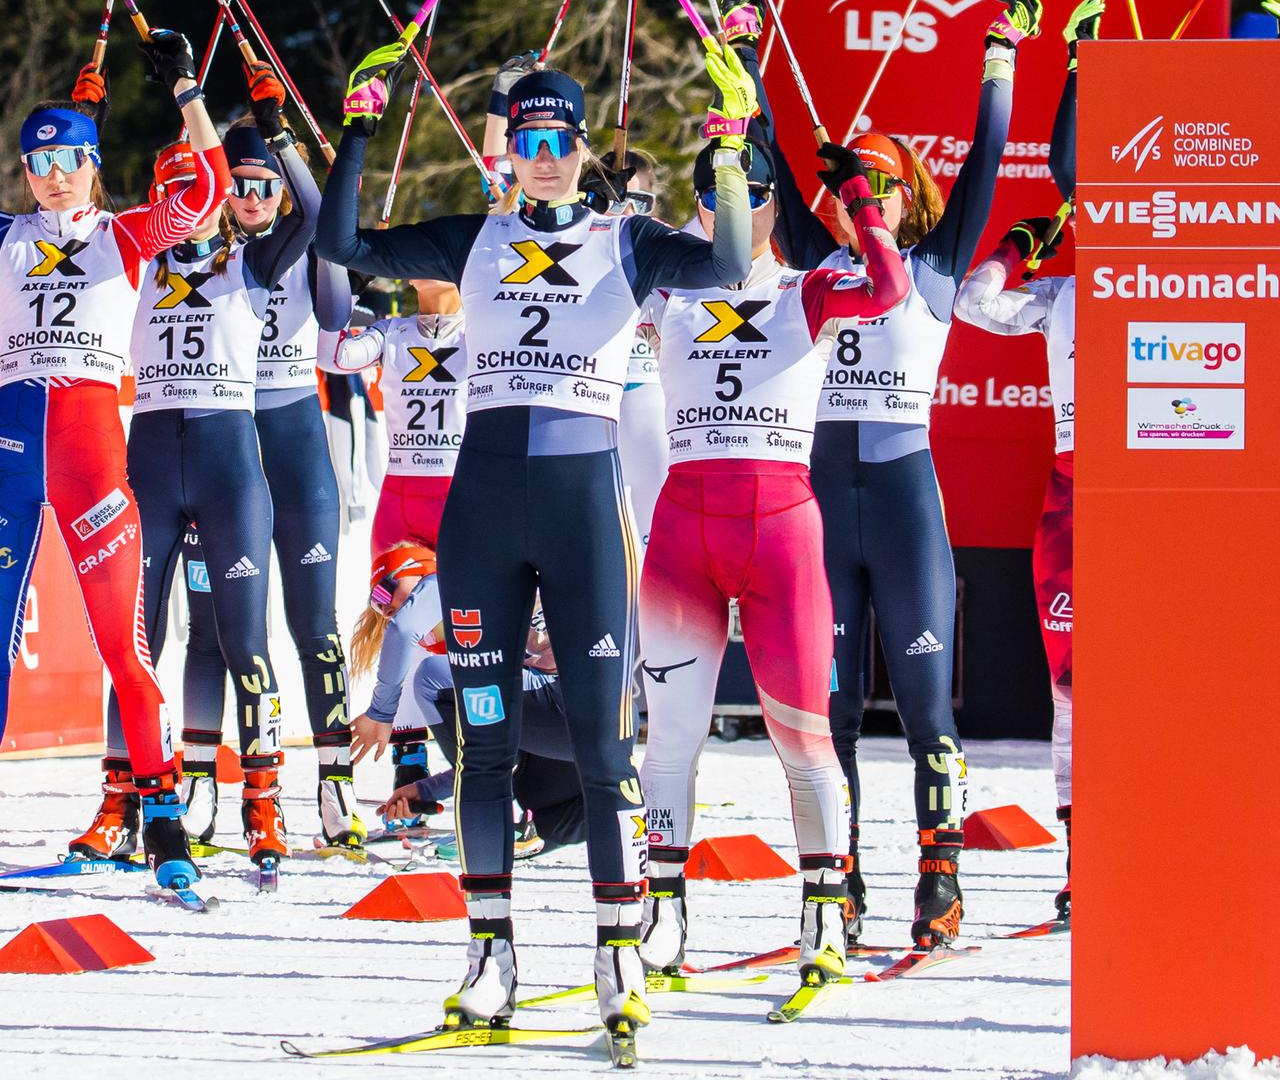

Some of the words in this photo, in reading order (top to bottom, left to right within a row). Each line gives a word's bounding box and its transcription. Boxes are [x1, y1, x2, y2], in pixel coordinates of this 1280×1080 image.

[846, 10, 938, 53] LBS
[521, 96, 574, 112] WÜRTH
[1174, 123, 1230, 136] NORDIC
[1174, 138, 1252, 151] COMBINED
[1174, 154, 1226, 167] WORLD
[1230, 154, 1259, 167] CUP
[21, 281, 89, 292] AXELENT
[1093, 264, 1279, 299] Schonach
[494, 291, 582, 304] AXELENT
[28, 292, 77, 328] 12
[149, 314, 215, 325] AXELENT
[518, 305, 550, 348] 2
[8, 330, 102, 349] SCHONACH
[158, 326, 205, 360] 15
[837, 329, 862, 366] 8
[1131, 335, 1241, 370] trivago
[688, 350, 772, 360] AXELENT
[477, 351, 597, 374] SCHONACH
[139, 363, 228, 380] SCHONACH
[517, 382, 554, 393] BURGER
[715, 363, 742, 402] 5
[401, 388, 458, 397] AXELENT
[407, 399, 445, 431] 21
[677, 407, 787, 425] SCHONACH
[1138, 422, 1236, 430] WirmachenDruck.de
[393, 433, 462, 446] SCHONAC
[714, 435, 748, 444] BURGER
[90, 503, 113, 523] CAISSE
[78, 532, 127, 575] CRAFT
[300, 553, 331, 565] adidas
[225, 568, 259, 579] adidas
[589, 649, 620, 657] adidas
[906, 643, 943, 655] adidas
[449, 650, 503, 667] WÜRTH
[470, 692, 499, 719] TQ
[81, 864, 116, 873] SALOMON
[455, 1032, 491, 1044] FISCHER
